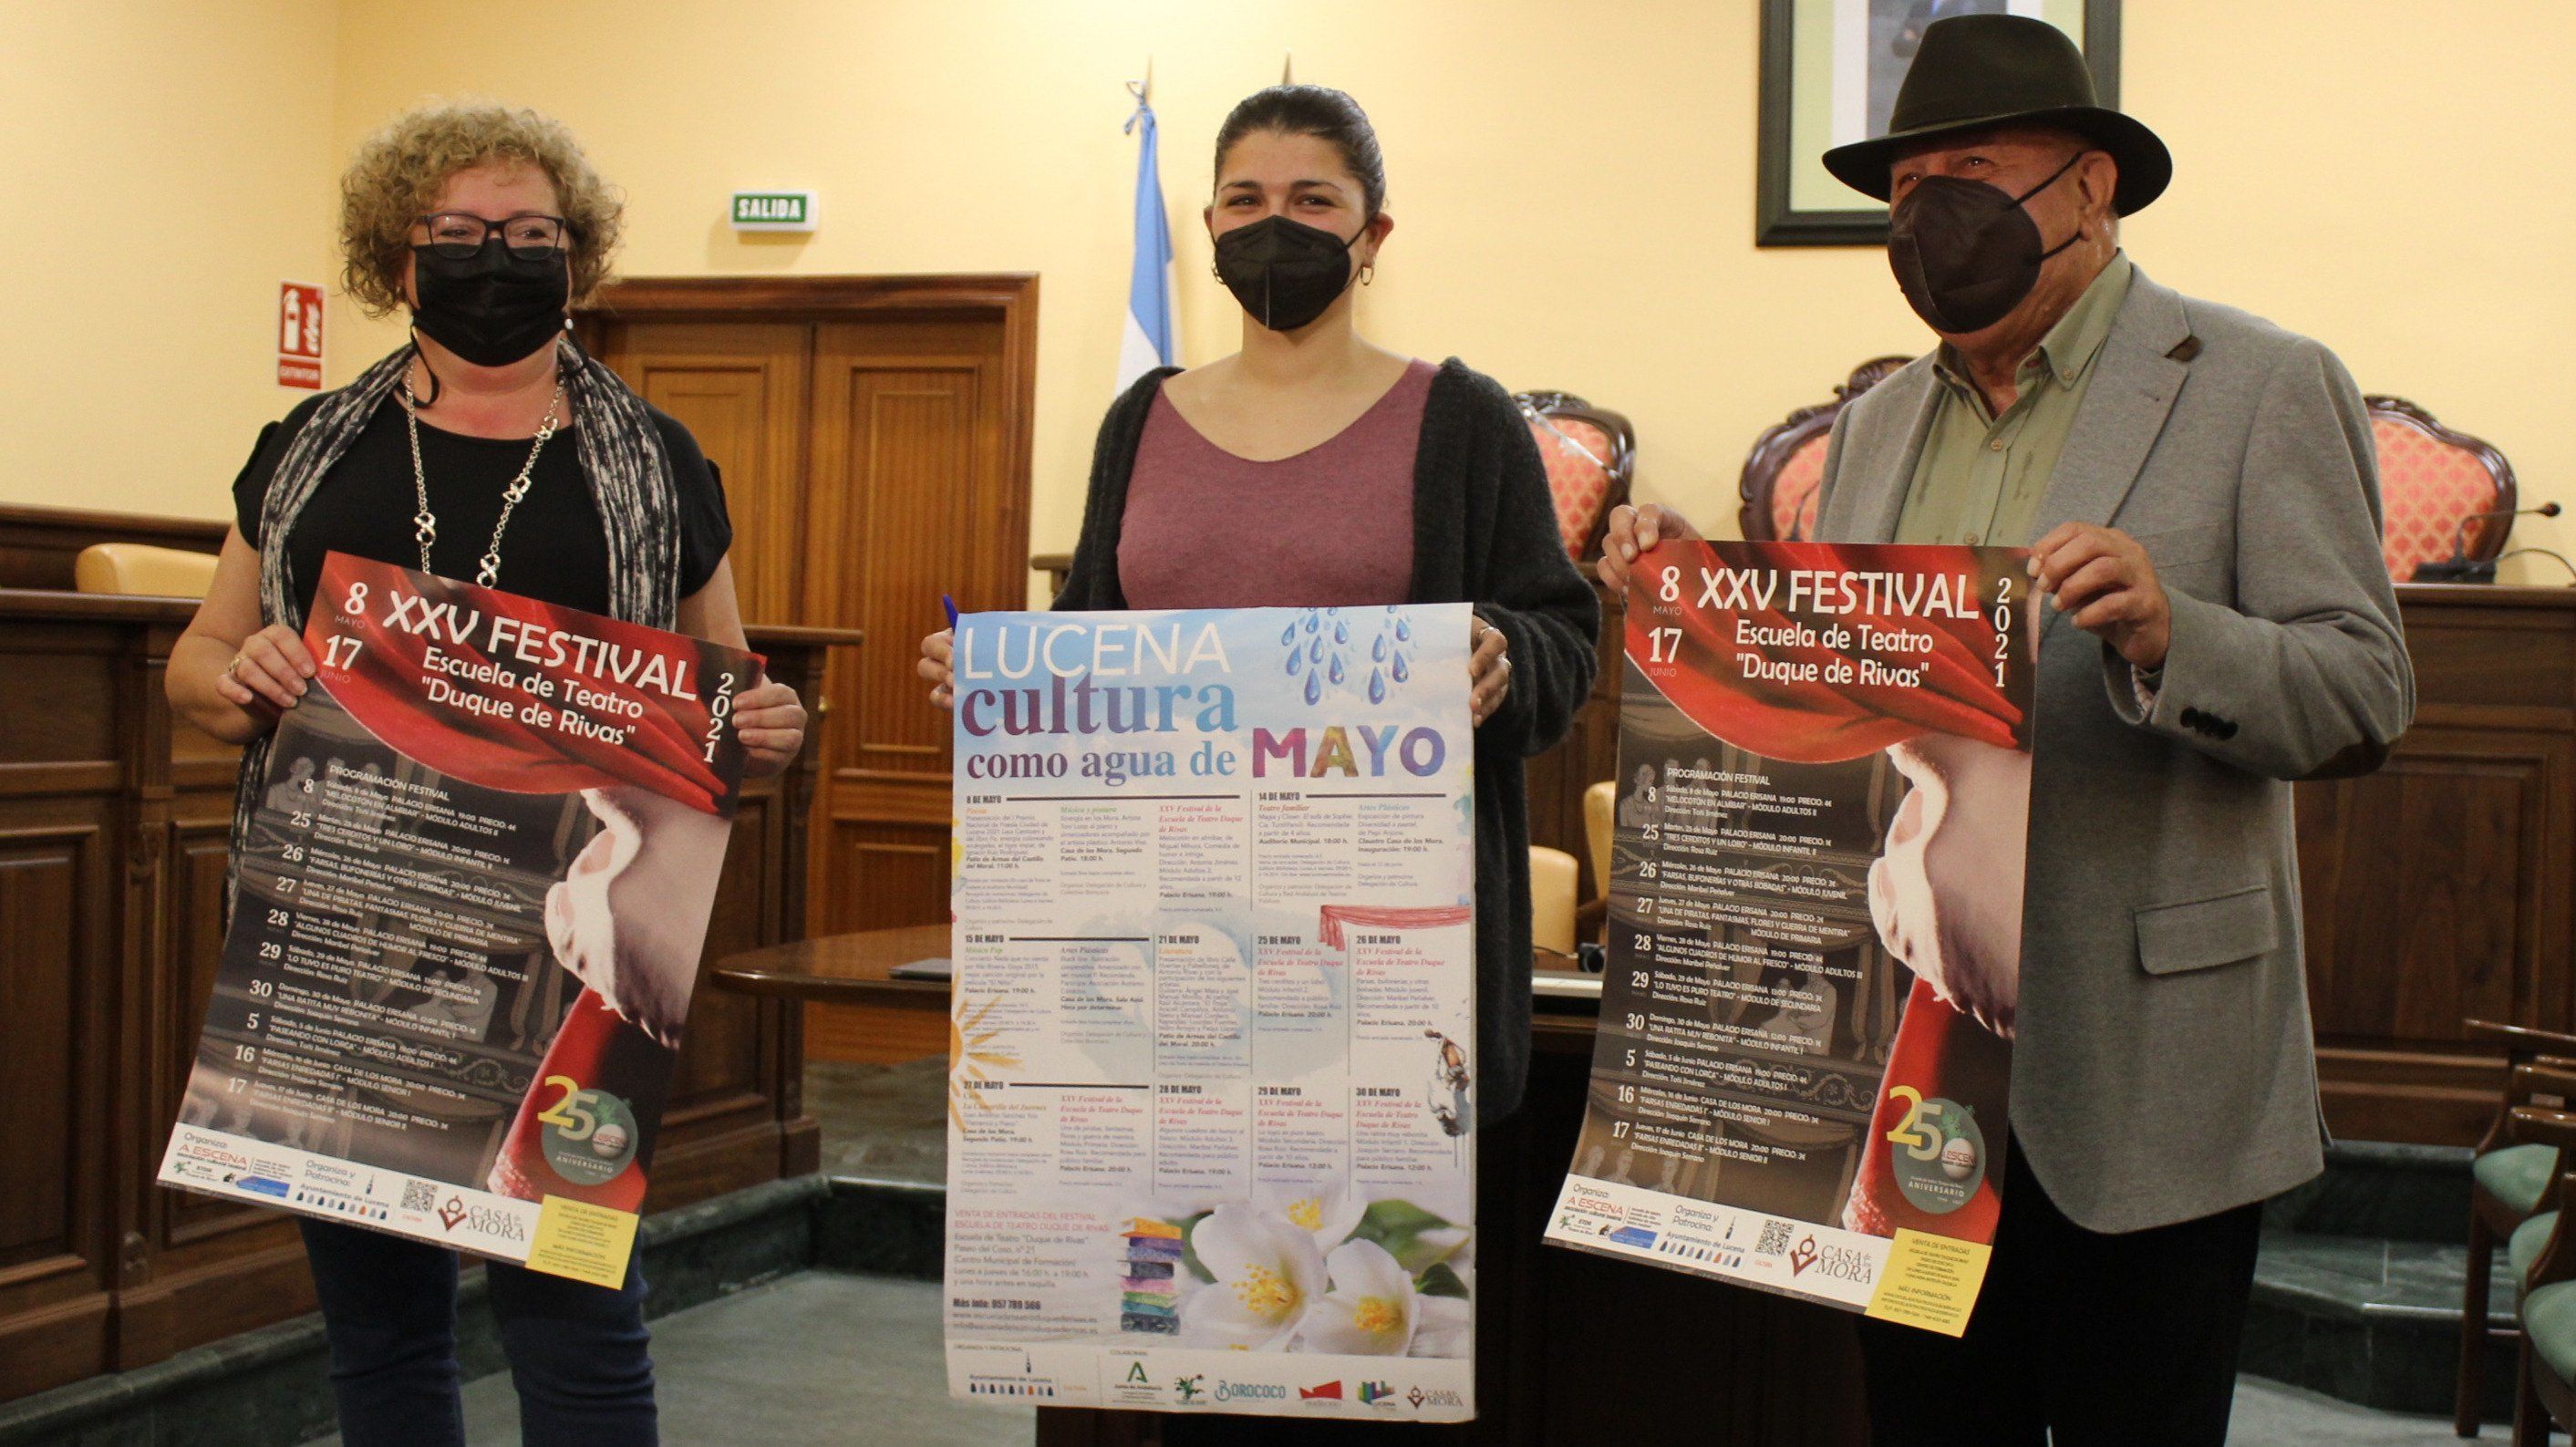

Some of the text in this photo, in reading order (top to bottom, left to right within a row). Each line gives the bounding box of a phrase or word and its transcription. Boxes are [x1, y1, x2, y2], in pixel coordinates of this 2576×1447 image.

[738, 198, 801, 218] SALIDA
[1658, 565, 1682, 602] 8
[1696, 566, 1983, 619] XXV FESTIVAL
[344, 582, 368, 615] 8
[1652, 605, 1681, 615] MAYO
[334, 615, 366, 630] MAYO
[1994, 577, 2012, 687] 2021
[382, 591, 698, 700] XXV FESTIVAL
[1644, 626, 1682, 663] 17
[1734, 619, 1934, 654] Escuela de Teatro
[322, 635, 363, 670] 17
[964, 621, 1231, 679] LUCENA
[319, 668, 351, 685] JUNIO
[1650, 667, 1677, 677] JUNIO
[1736, 653, 1929, 688] "Duque de Rivas"
[423, 646, 643, 718] Escuela de Teatro
[422, 676, 636, 747] "Duque de Rivas"
[961, 669, 1237, 736] cultura
[705, 673, 735, 762] 2021
[967, 725, 1446, 787] como agua de MAYO
[302, 778, 315, 793] 8
[328, 764, 450, 801] PROGRAMACIÓN FESTIVAL
[1667, 767, 1771, 785] PROGRAMACIÓN FESTIVAL
[967, 795, 1001, 803] 8 DE MAYO
[1259, 792, 1266, 801] 14
[1268, 792, 1278, 801] DE
[1647, 787, 1657, 802] 8
[289, 810, 312, 828] 25
[1641, 823, 1660, 841] 25
[281, 843, 305, 863] 26
[1639, 861, 1657, 878] 26
[274, 875, 296, 894] 27
[1636, 896, 1653, 914] 27
[265, 907, 291, 927] 28
[965, 935, 973, 943] 15
[976, 935, 984, 943] DE
[1159, 935, 1199, 944] 21 DE MAYO
[1257, 935, 1300, 945] 25 DE MAYO
[1357, 935, 1401, 944] 26 DE MAYO
[1633, 934, 1652, 951] 28
[258, 941, 282, 960] 29
[248, 978, 273, 998] 30
[1630, 970, 1650, 988] 29
[245, 1011, 261, 1030] 5
[1626, 1012, 1645, 1030] 30
[233, 1043, 255, 1063] 16
[1625, 1048, 1636, 1067] 5
[225, 1076, 247, 1095] 17
[974, 1081, 983, 1090] DE
[985, 1081, 1003, 1090] MAYO
[1159, 1085, 1201, 1094] 28 DE MAYO
[1257, 1086, 1301, 1095] 29 DE MAYO
[1356, 1088, 1400, 1097] 30 DE MAYO
[1617, 1083, 1635, 1103] 16
[537, 1076, 600, 1140] 25
[1611, 1120, 1629, 1140] 17
[1886, 1085, 1942, 1161] 25
[192, 1145, 249, 1166] ESCENA
[1908, 1180, 1964, 1198] ANIVERSARIO
[1578, 1196, 1624, 1215] ESCENA
[465, 1214, 527, 1242] MORA
[1821, 1244, 1864, 1266] CASA
[1815, 1256, 1872, 1285] MORA
